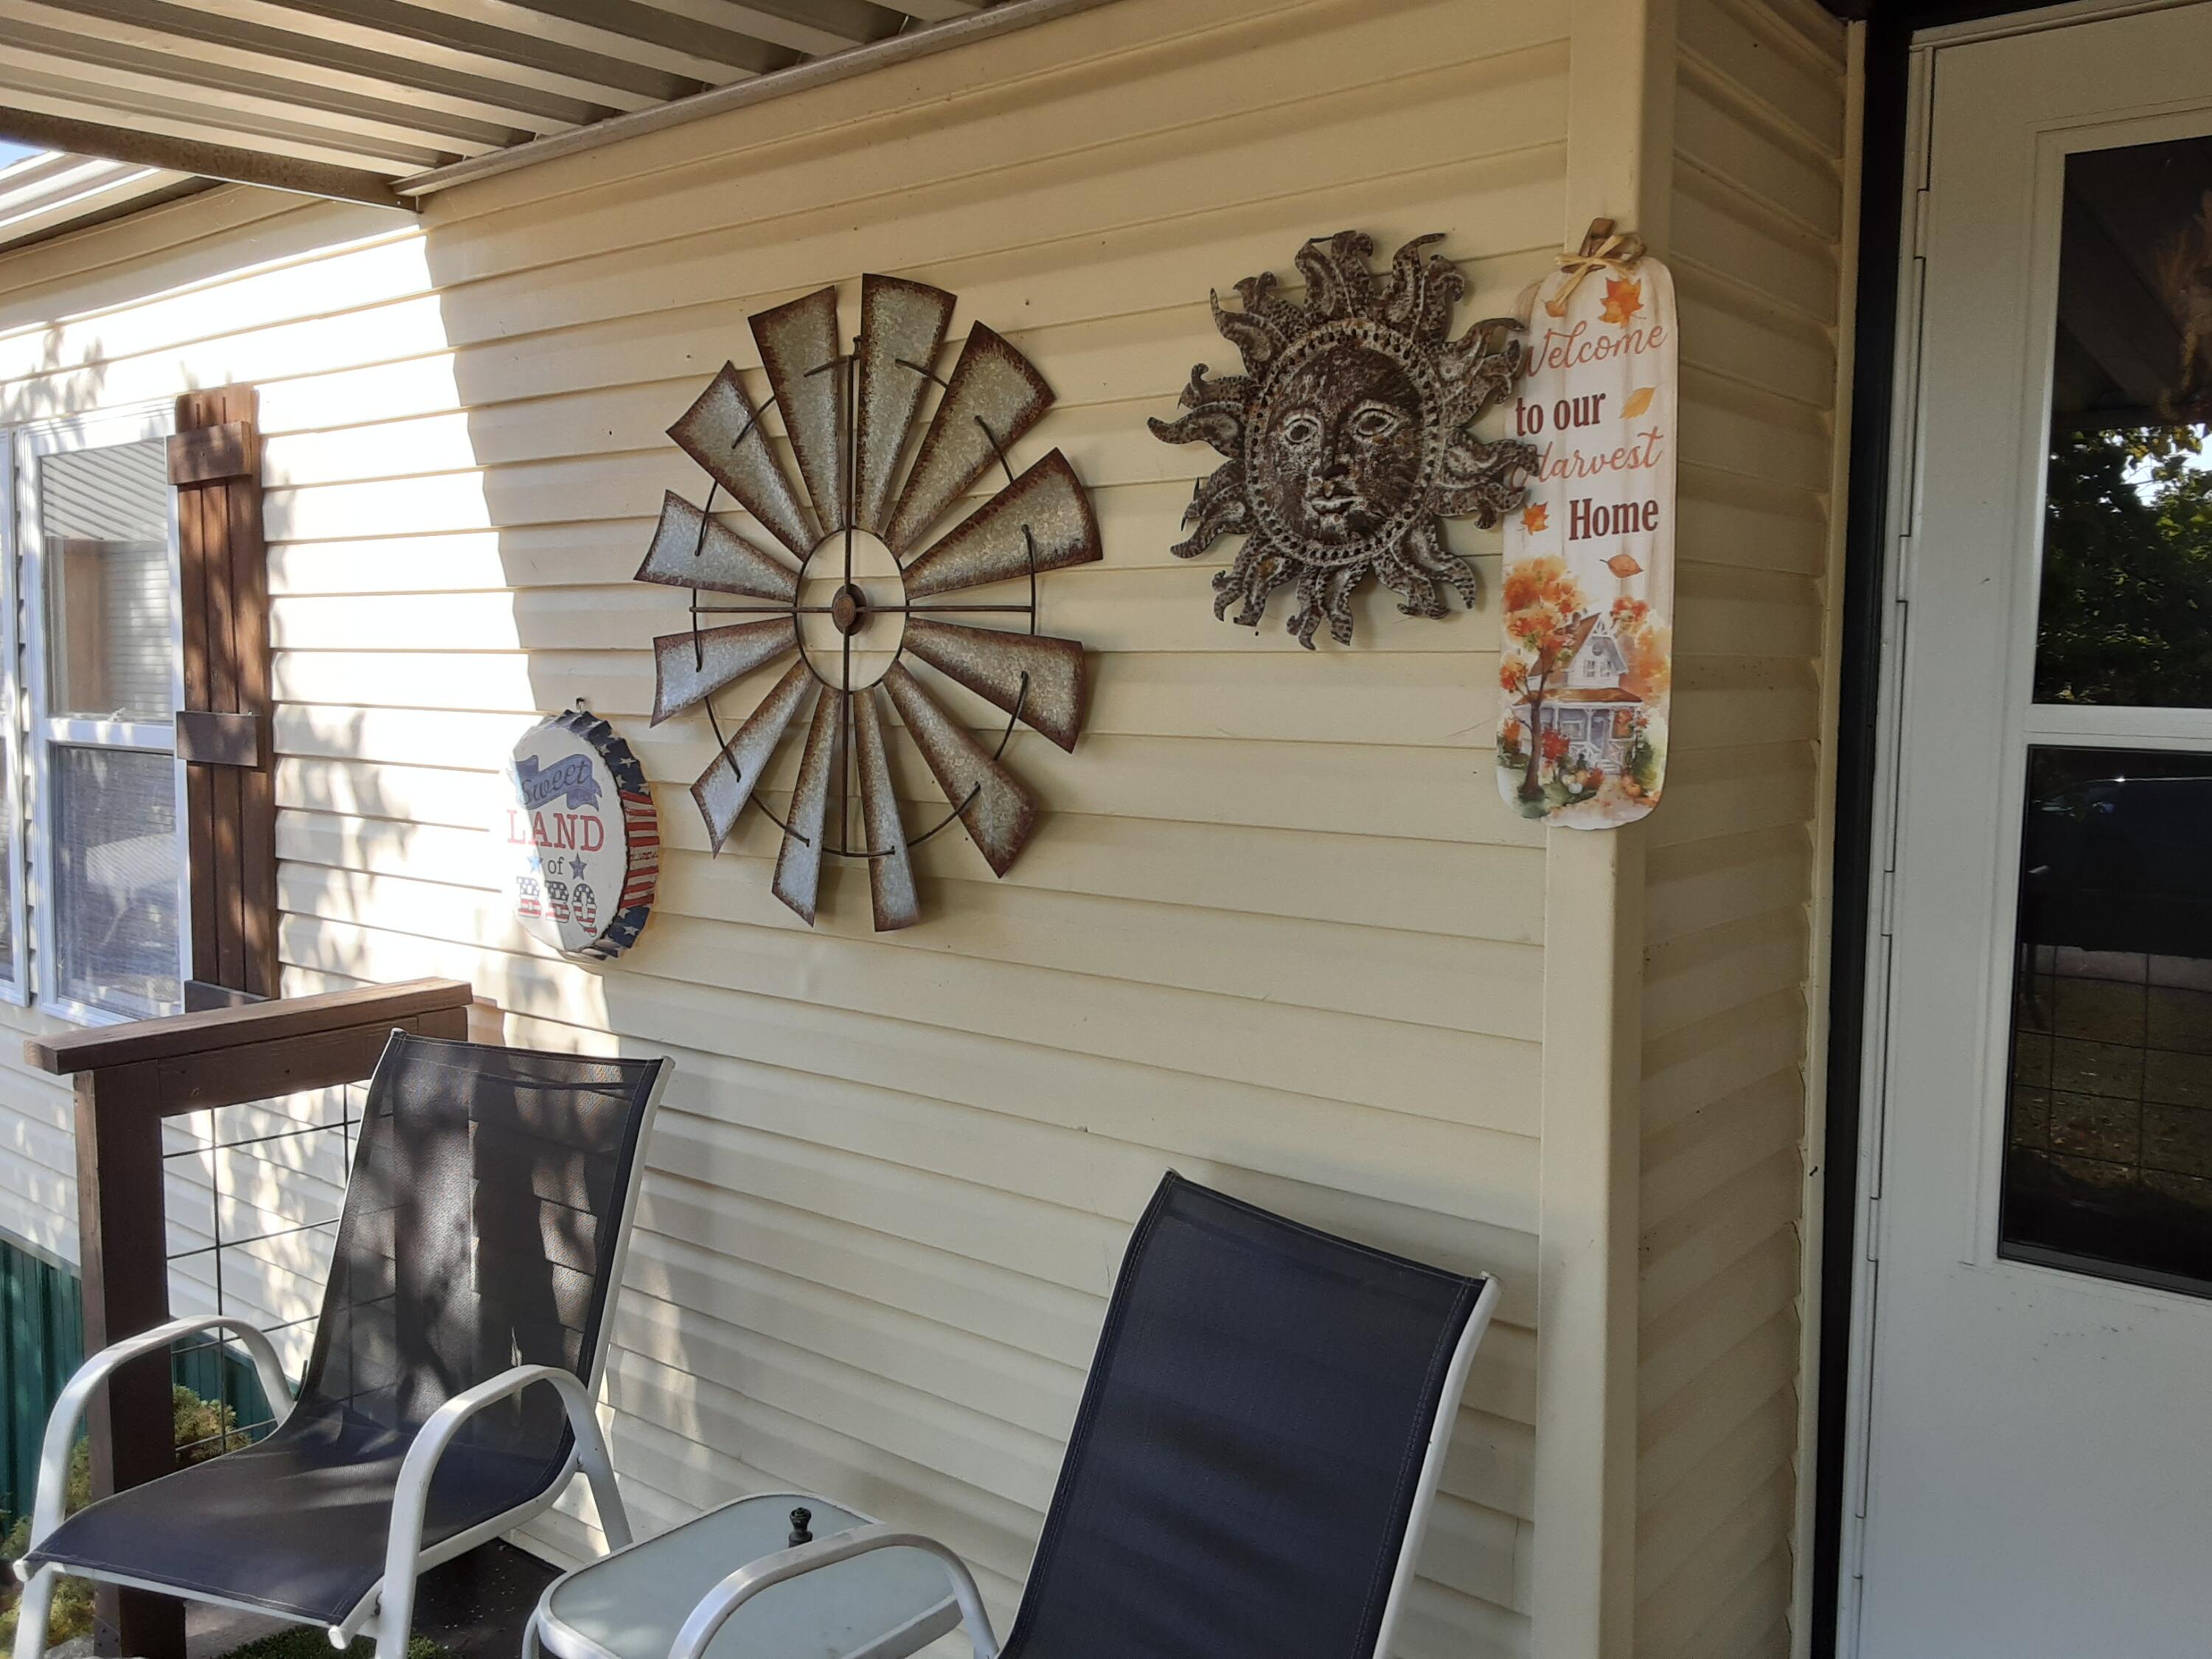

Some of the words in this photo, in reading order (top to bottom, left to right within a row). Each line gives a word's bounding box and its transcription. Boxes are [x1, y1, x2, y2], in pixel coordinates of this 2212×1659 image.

[1515, 397, 1543, 437] to
[1553, 392, 1606, 431] our
[1568, 498, 1659, 540] Home
[519, 759, 590, 806] Sweet
[507, 809, 605, 852] LAND
[547, 856, 565, 875] of
[516, 876, 598, 938] BBQ
